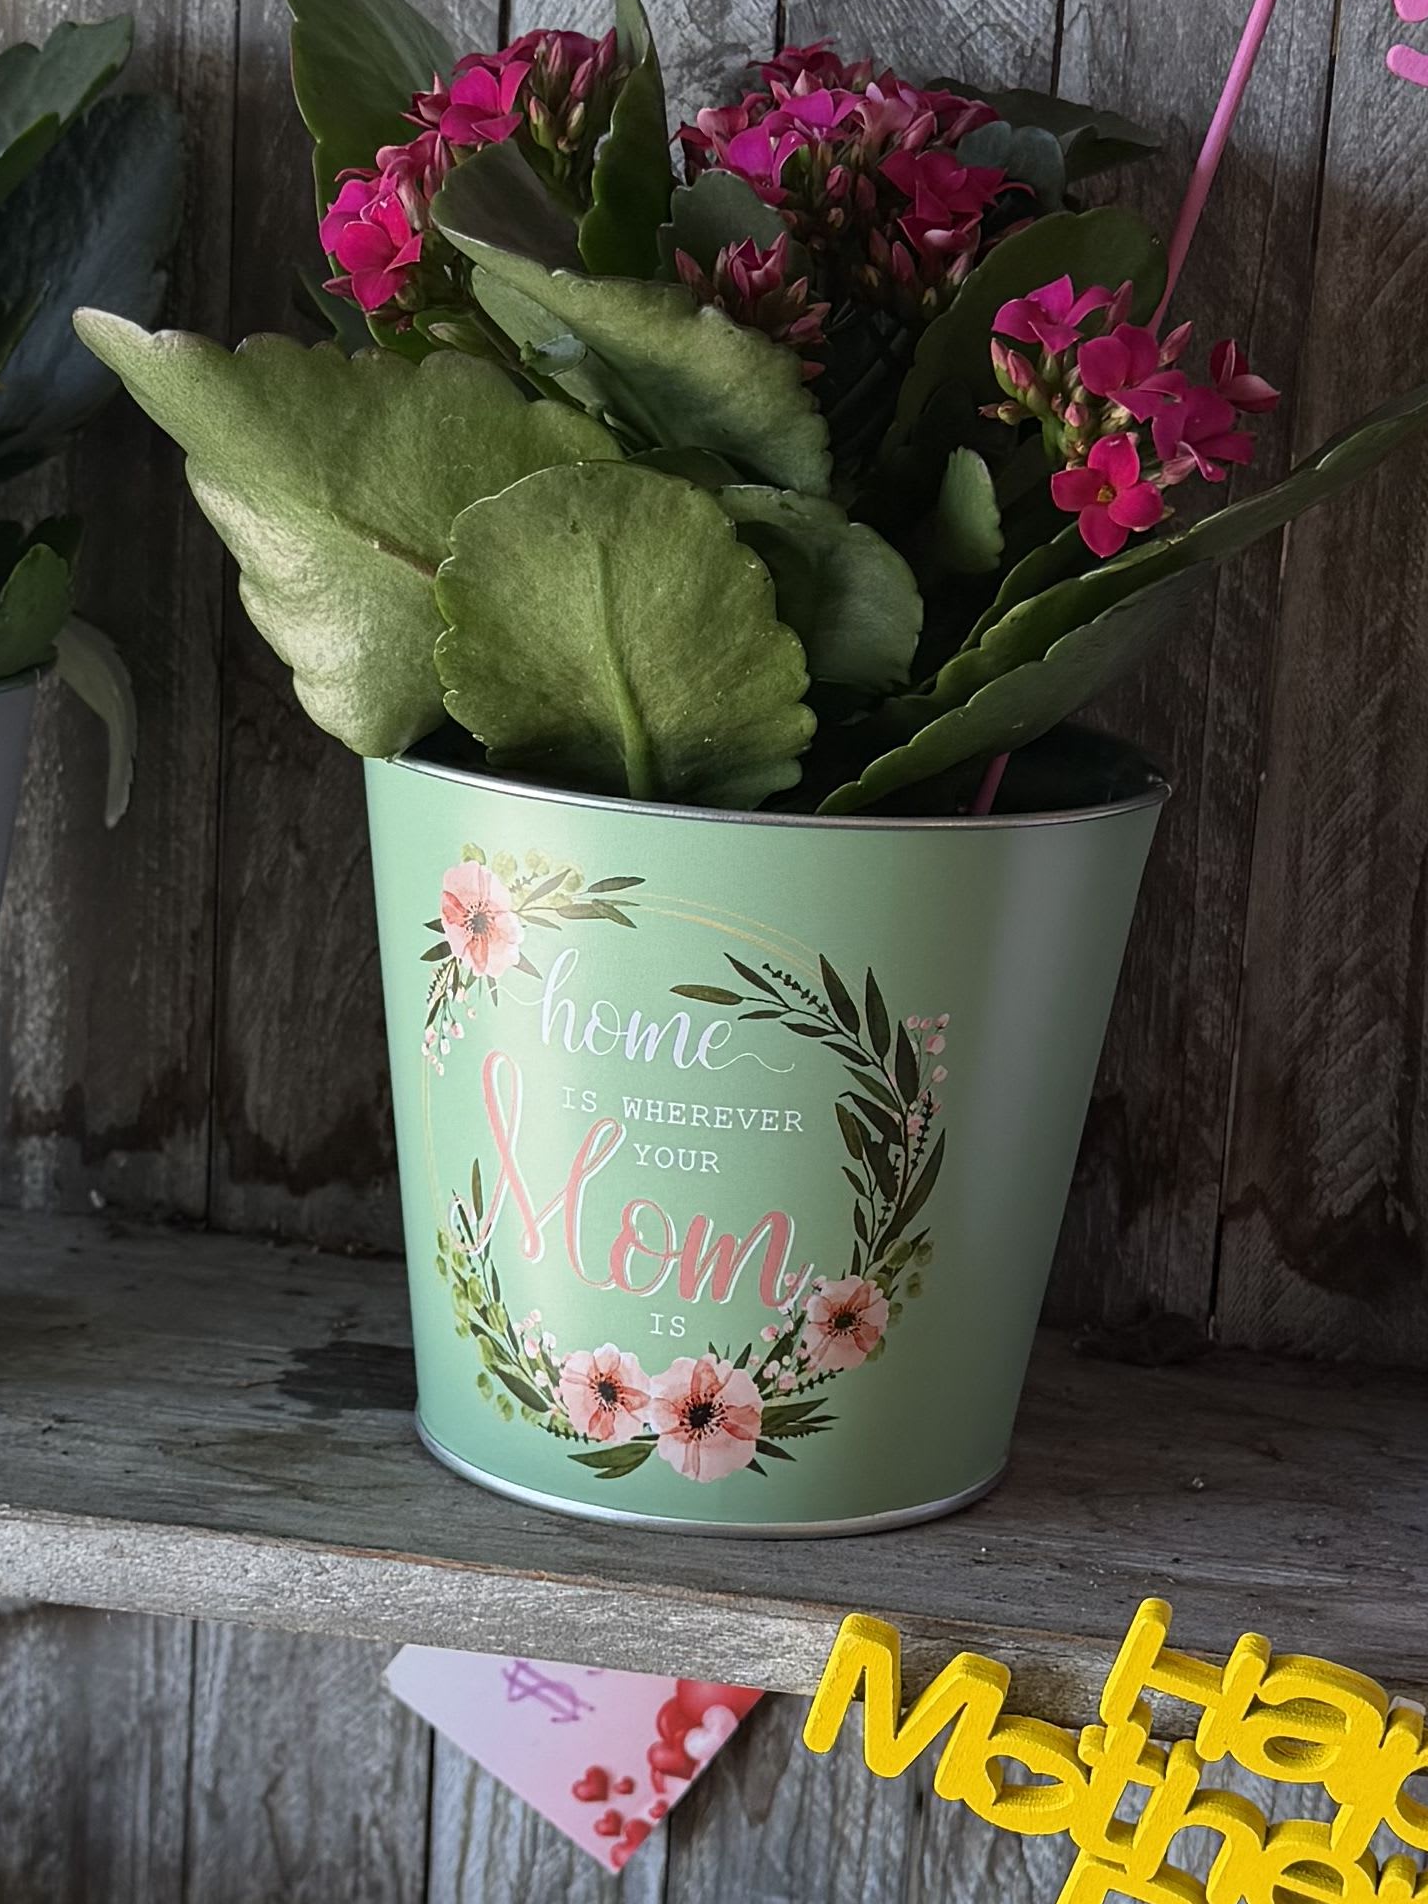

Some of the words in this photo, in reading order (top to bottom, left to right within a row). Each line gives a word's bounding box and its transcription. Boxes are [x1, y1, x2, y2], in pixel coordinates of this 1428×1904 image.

[485, 948, 795, 1073] home
[561, 1086, 598, 1112] IS
[622, 1097, 804, 1132] WHEREVER
[449, 1050, 815, 1309] Mom
[634, 1143, 721, 1174] YOUR
[649, 1313, 686, 1338] IS
